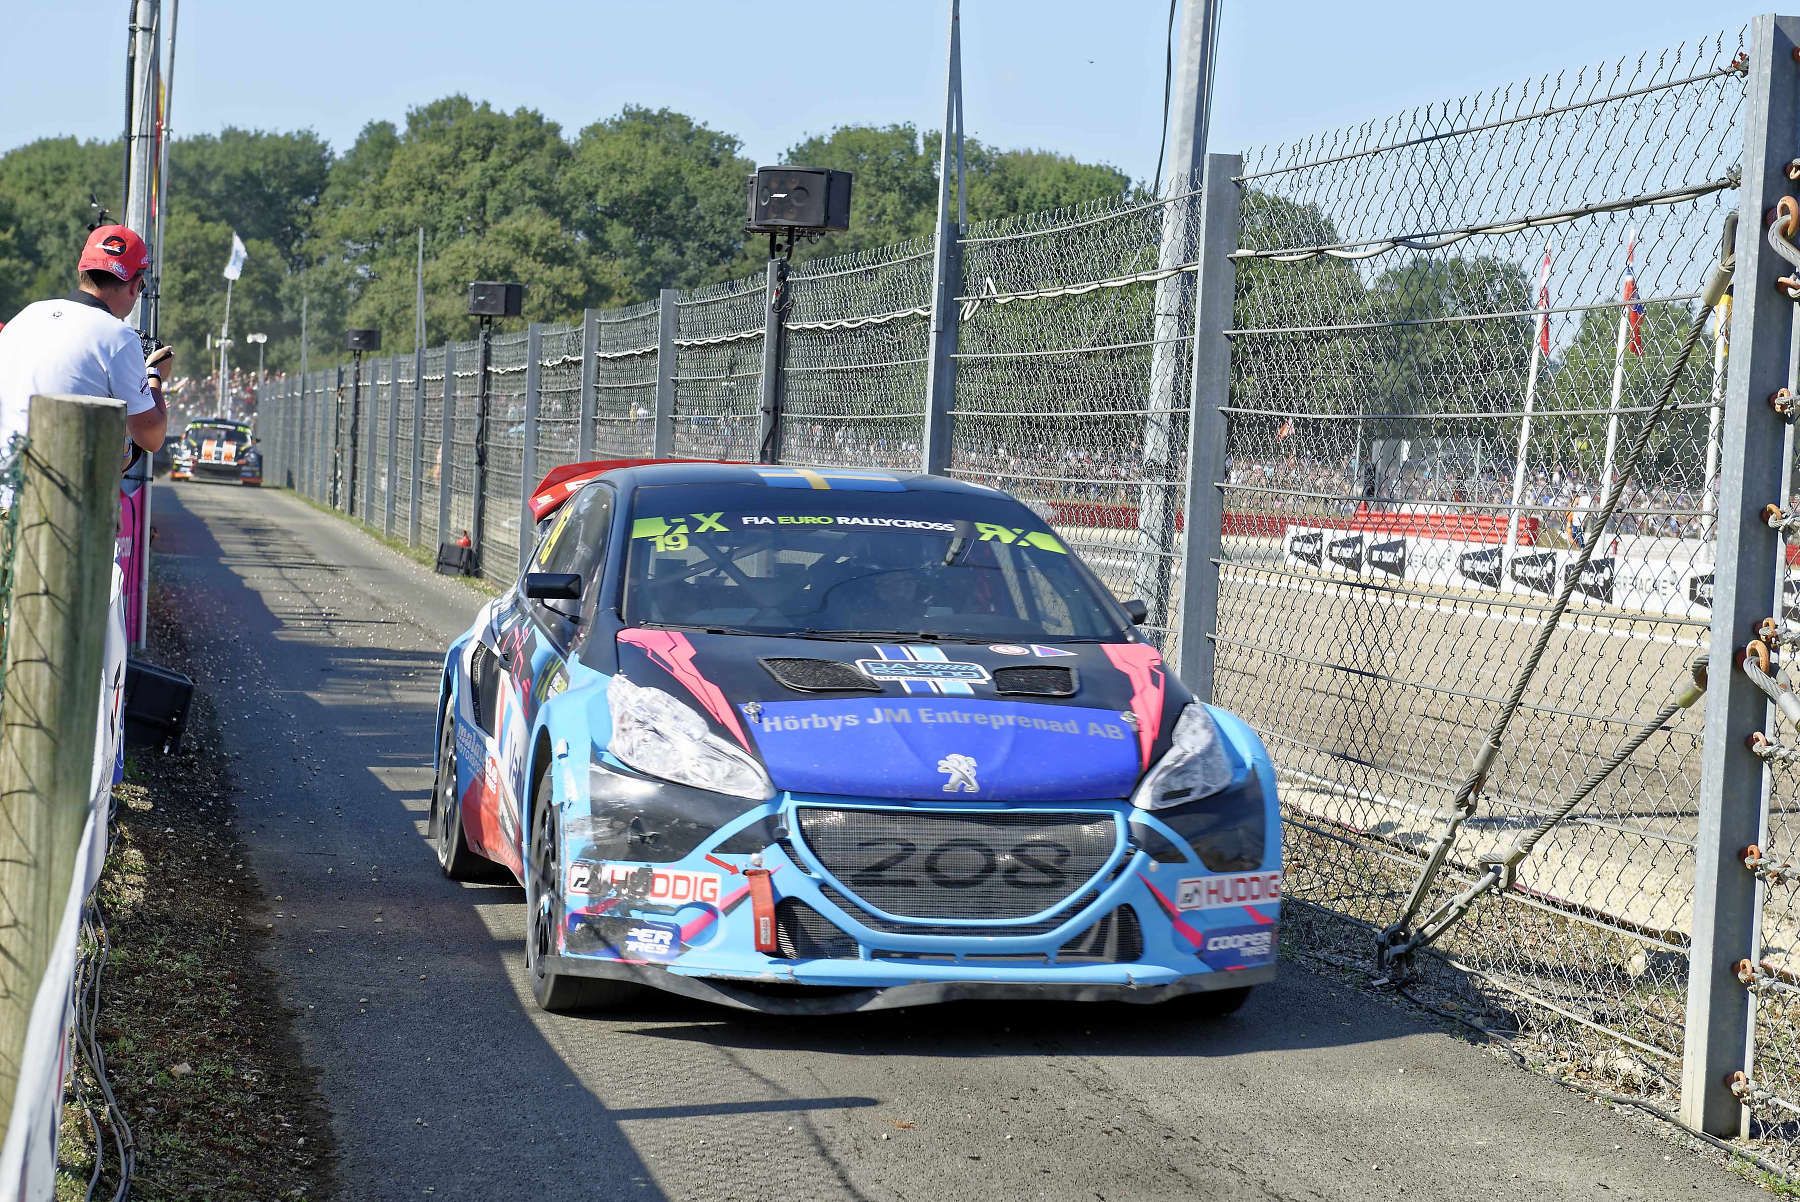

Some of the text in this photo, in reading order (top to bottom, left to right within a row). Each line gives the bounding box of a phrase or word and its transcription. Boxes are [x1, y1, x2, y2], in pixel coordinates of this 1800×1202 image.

[742, 516, 956, 532] FIA EURO RALLYCROSS
[648, 533, 689, 552] 19
[763, 707, 1125, 739] Hörbys JM Entreprenad AB
[851, 837, 1074, 890] 208
